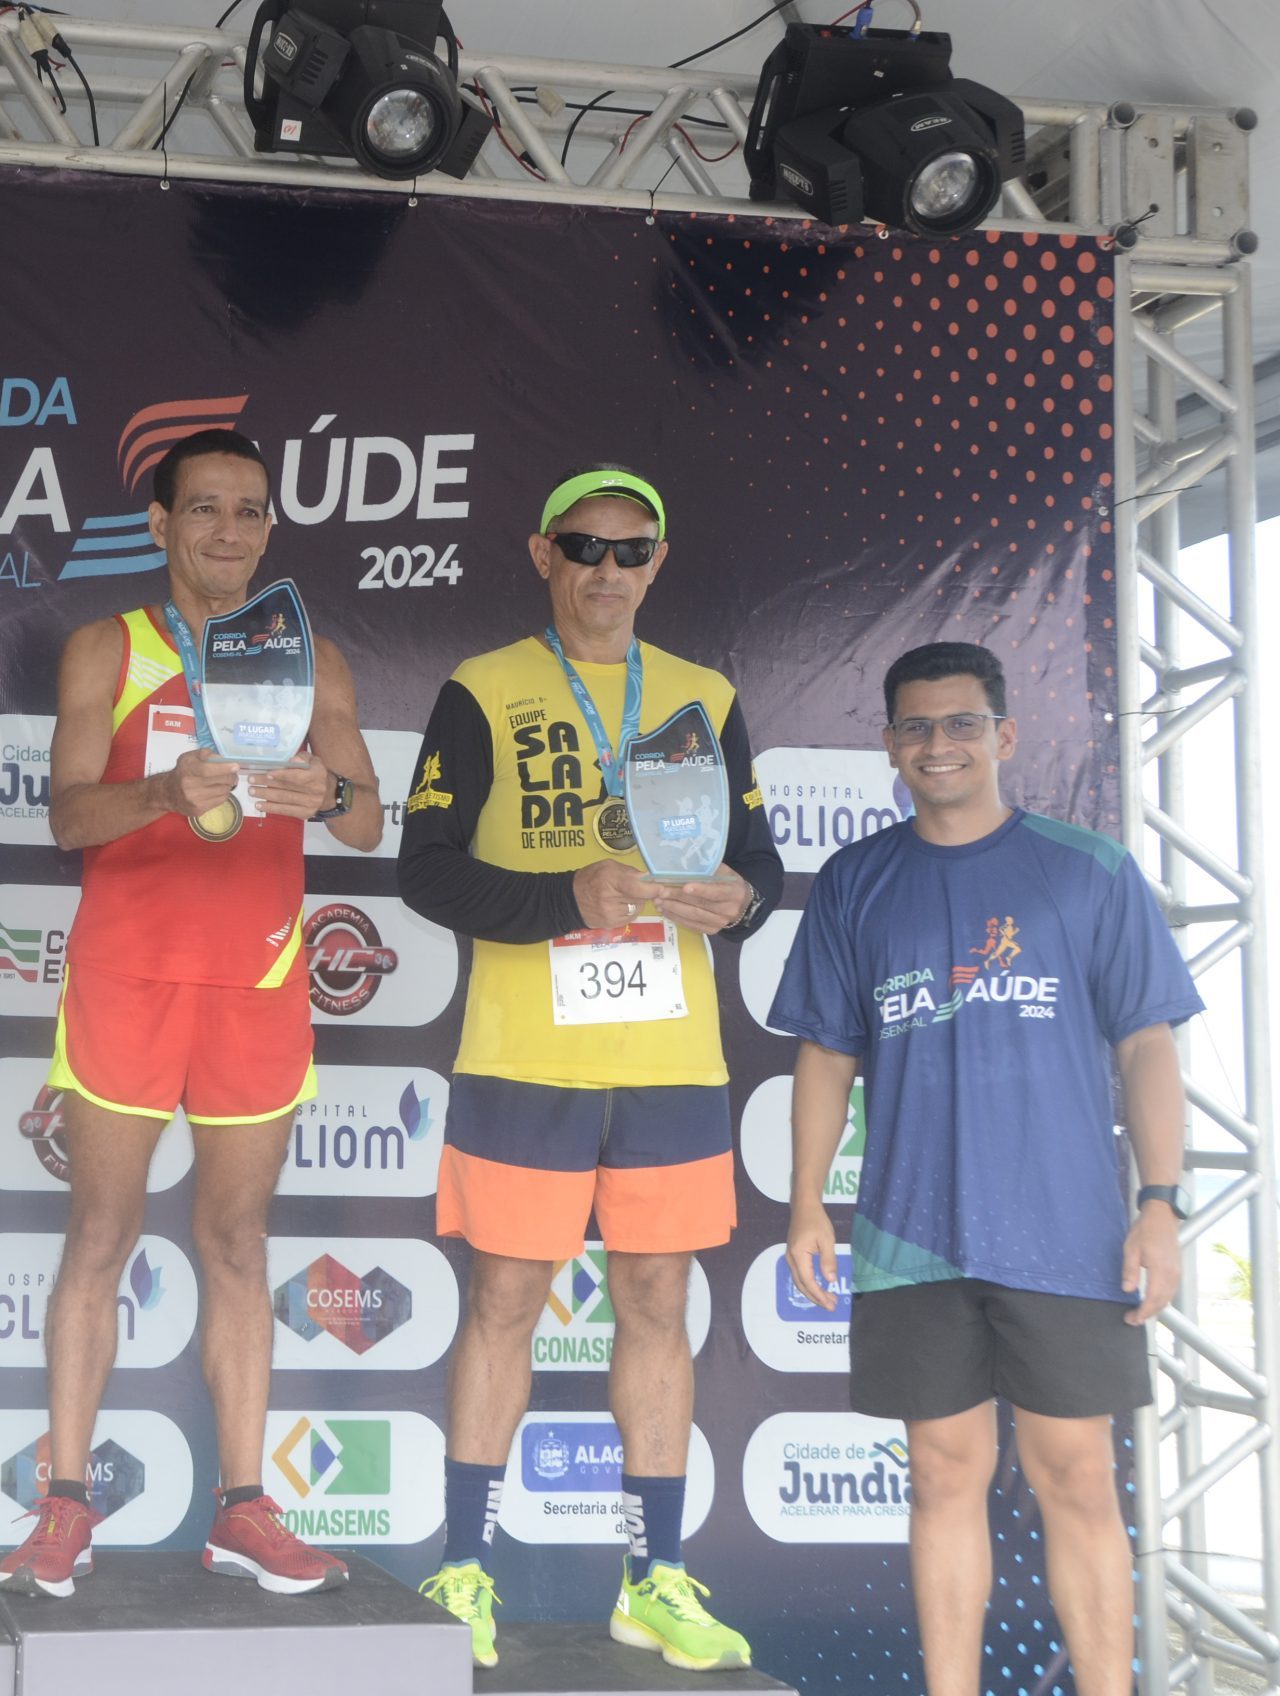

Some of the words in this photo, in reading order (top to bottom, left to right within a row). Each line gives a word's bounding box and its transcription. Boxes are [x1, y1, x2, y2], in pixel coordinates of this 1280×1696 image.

[358, 543, 464, 589] 2024
[213, 641, 246, 652] PELA
[509, 709, 547, 729] EQUIPE
[248, 725, 275, 734] LUGAR
[513, 721, 580, 760] SA
[517, 754, 582, 792] LA
[635, 760, 665, 771] PELA
[770, 784, 864, 800] HOSPITAL
[521, 792, 584, 829] DA
[671, 817, 695, 827] LUGAR
[522, 831, 535, 849] DE
[539, 829, 585, 849] FRUTAS
[311, 908, 369, 932] ACADEMIA
[580, 960, 647, 999] 394
[309, 987, 370, 1011] FITNESS
[880, 987, 936, 1023] ELA
[1019, 1004, 1056, 1019] 2024
[306, 1289, 382, 1308] COSEMS
[783, 1443, 841, 1460] Cidade
[845, 1443, 865, 1460] de
[544, 1501, 607, 1515] Secretaria
[780, 1505, 839, 1516] ACELERAR
[842, 1505, 872, 1516] PARA
[272, 1509, 390, 1537] ONASEMS
[622, 1489, 648, 1557] RUN
